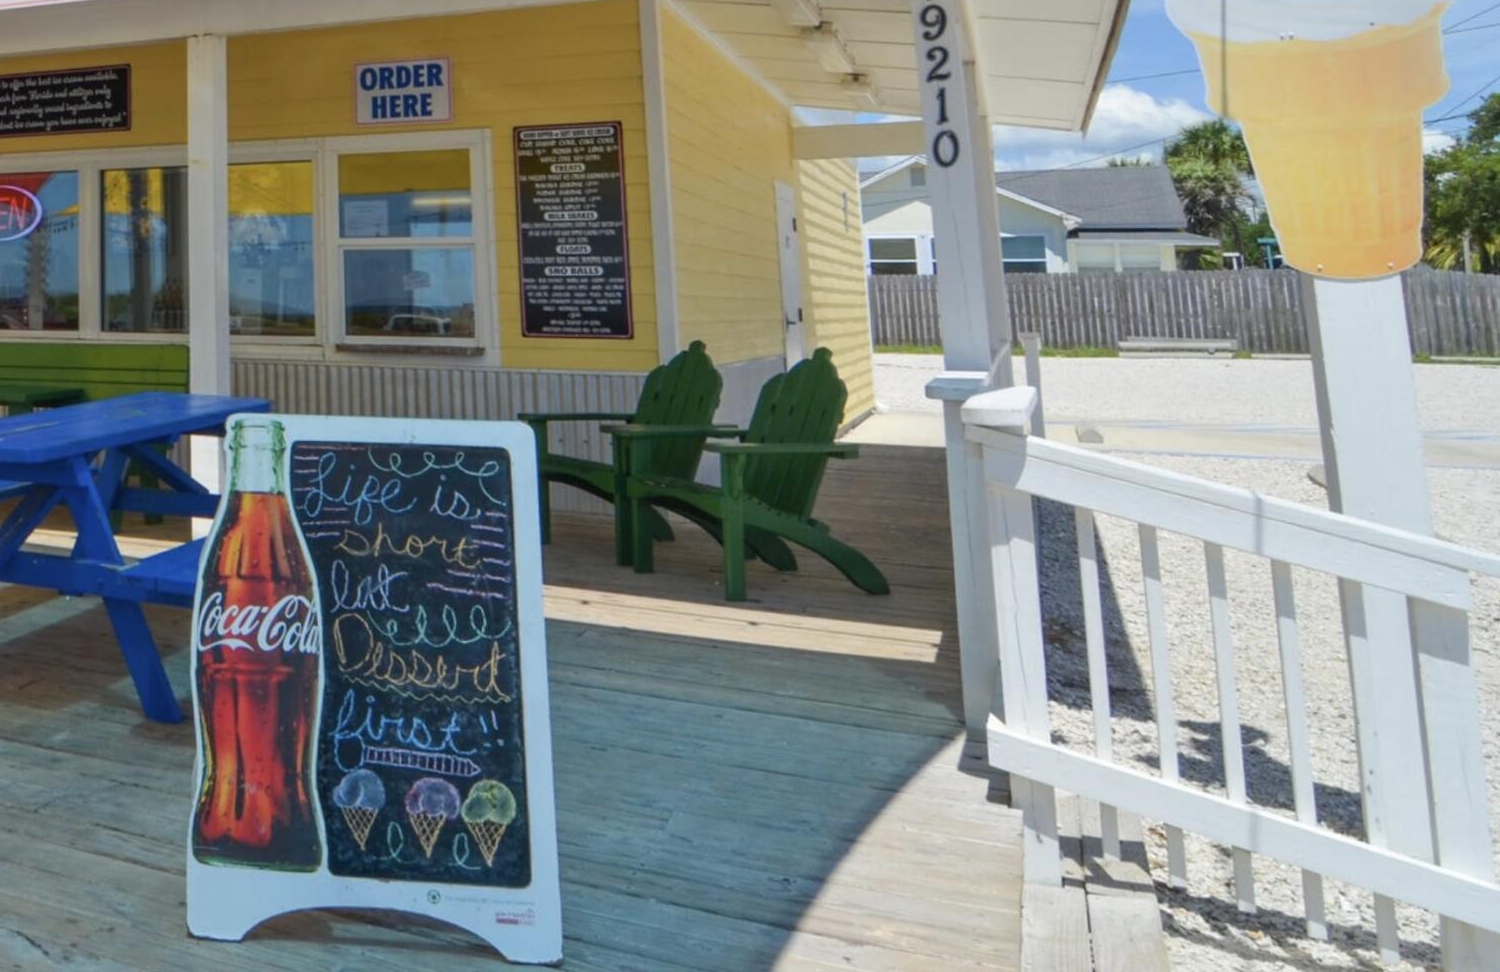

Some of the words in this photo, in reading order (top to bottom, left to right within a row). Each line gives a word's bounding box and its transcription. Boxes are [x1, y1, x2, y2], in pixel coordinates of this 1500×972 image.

[360, 63, 444, 91] ORDER
[372, 93, 433, 119] HERE
[304, 452, 417, 525] Life
[429, 474, 481, 520] is
[333, 522, 483, 569] short
[198, 591, 320, 655] Coca-Cola
[334, 613, 508, 700] Dessert
